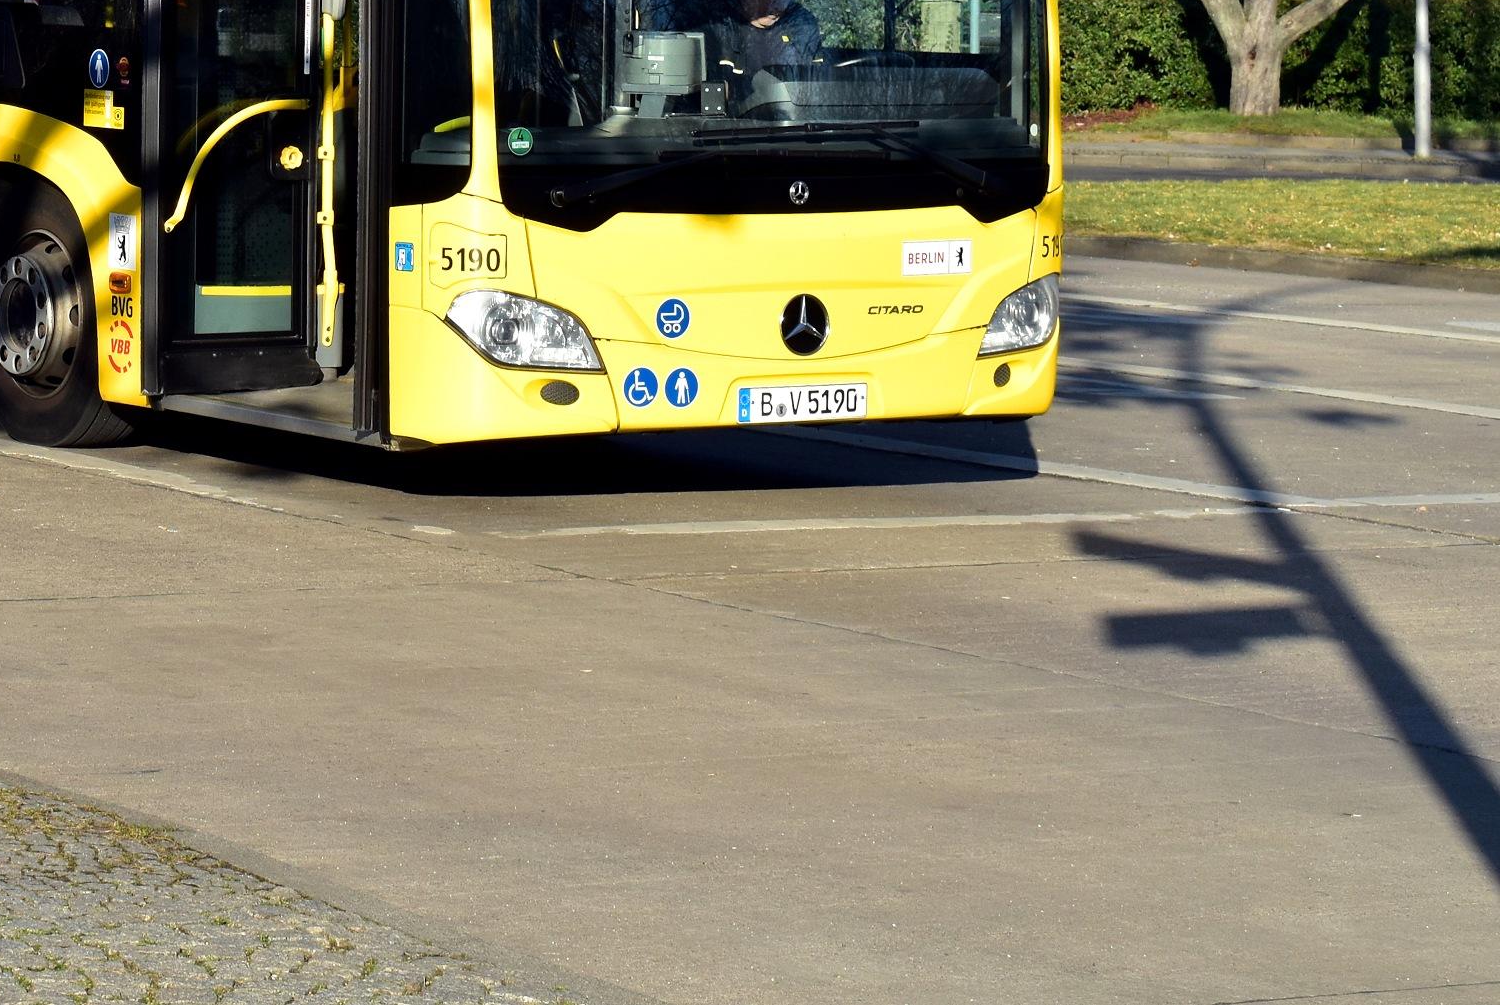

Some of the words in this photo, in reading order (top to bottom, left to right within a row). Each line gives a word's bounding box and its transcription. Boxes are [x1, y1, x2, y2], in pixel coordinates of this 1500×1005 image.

[517, 130, 524, 141] 4
[1042, 235, 1063, 258] 519
[441, 247, 501, 272] 5190
[908, 252, 945, 265] BERLIN
[111, 295, 133, 318] BVG
[868, 305, 924, 315] CITARO
[110, 338, 131, 355] VBB
[761, 392, 773, 416] B
[790, 391, 802, 415] V
[808, 388, 857, 414] 5190
